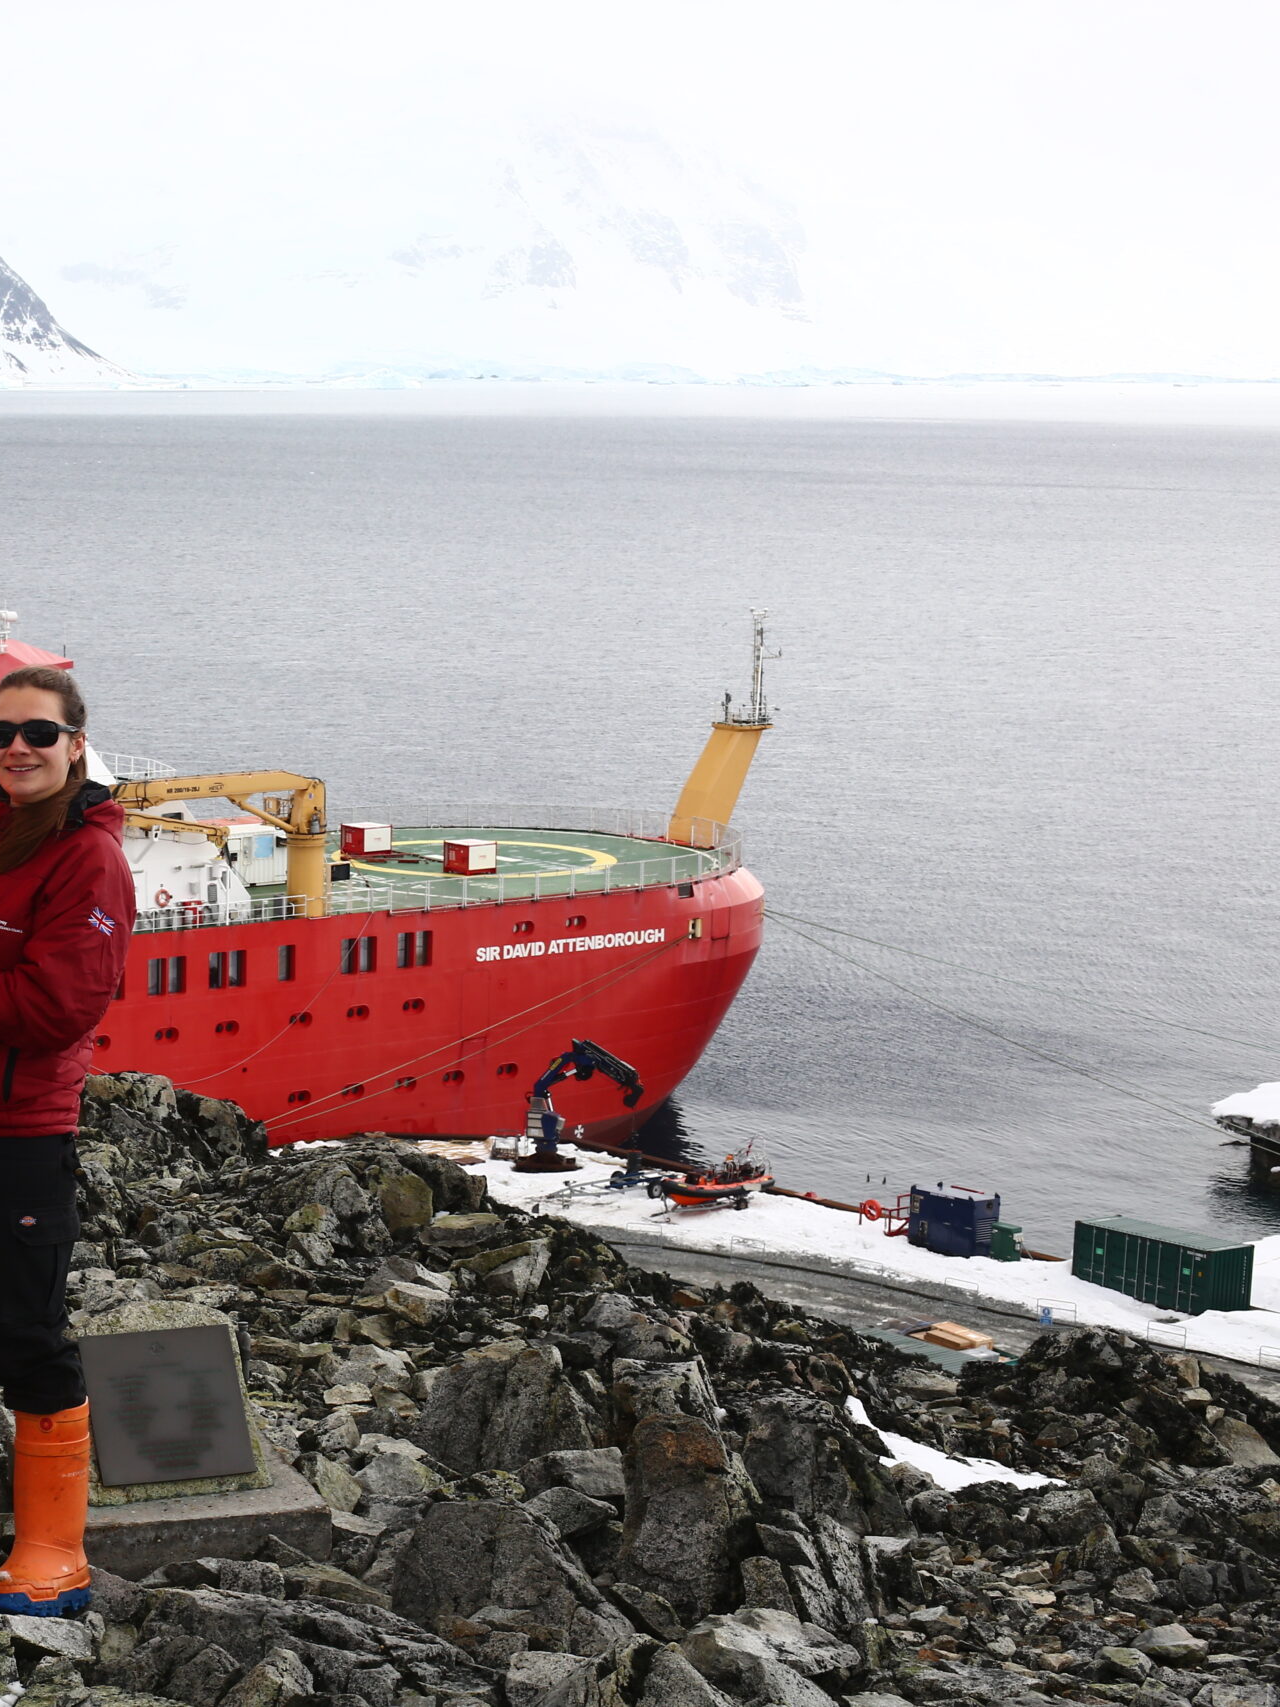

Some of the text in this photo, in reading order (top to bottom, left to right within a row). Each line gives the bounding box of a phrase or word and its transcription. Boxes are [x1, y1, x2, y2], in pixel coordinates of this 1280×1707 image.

[476, 928, 665, 962] SIR DAVID ATTENBOROUGH
